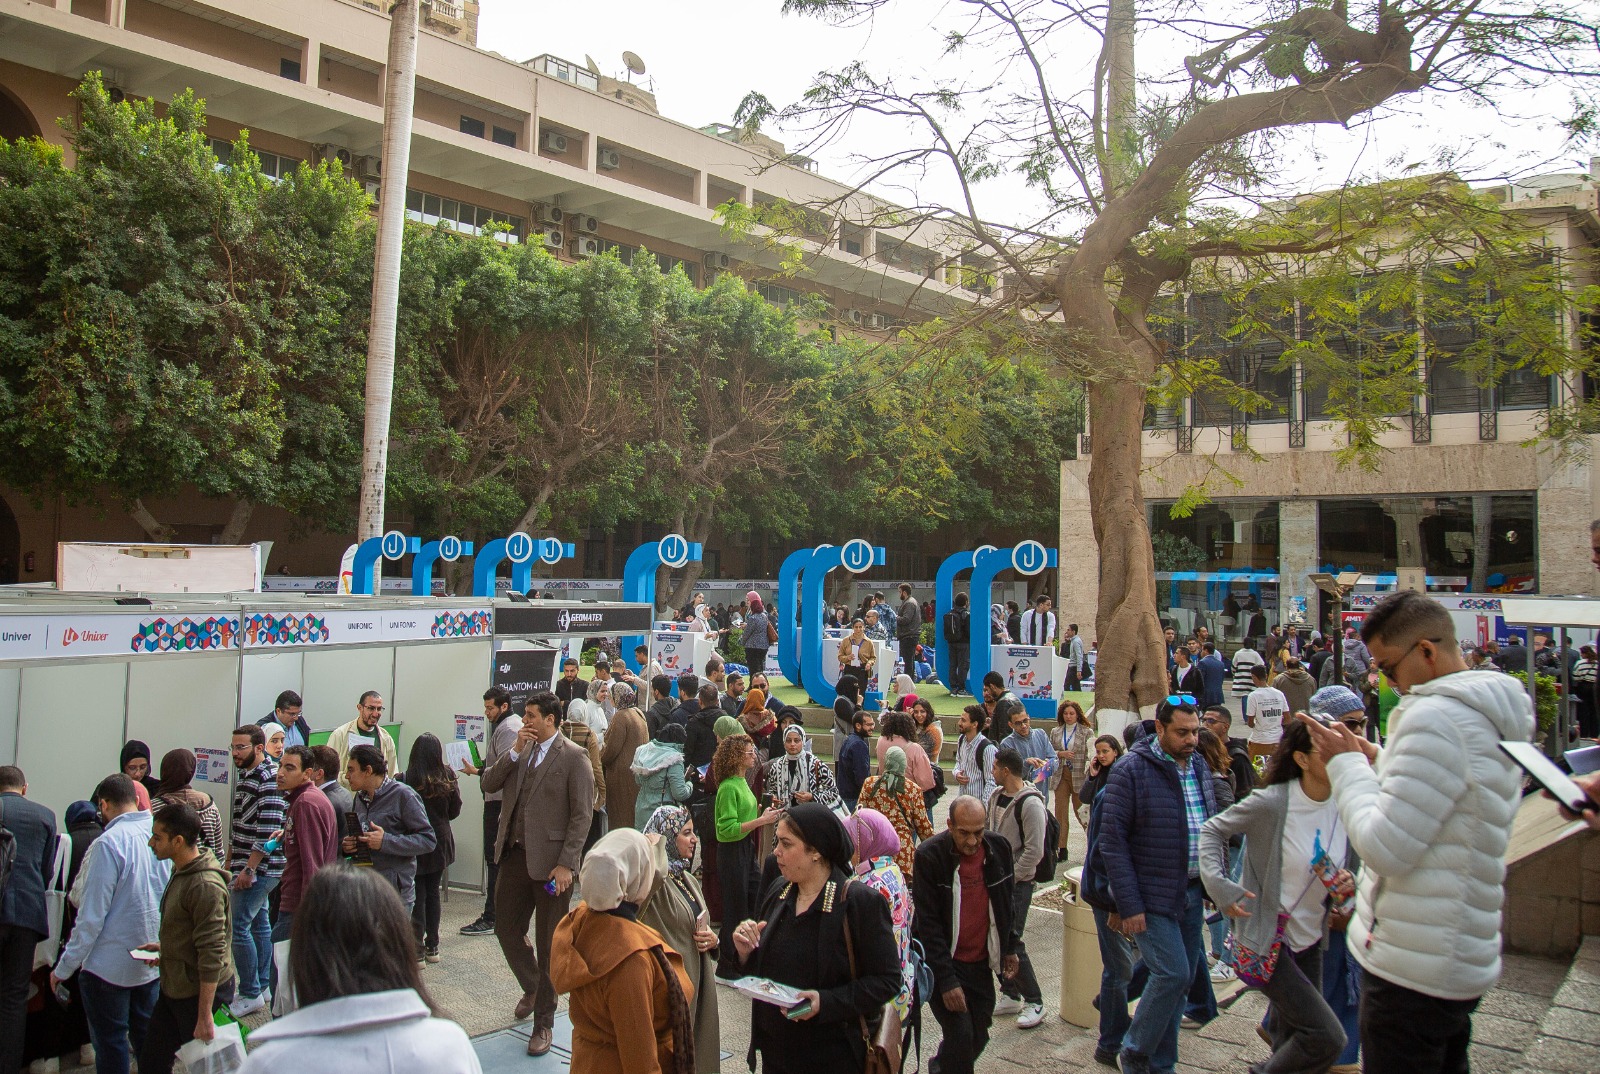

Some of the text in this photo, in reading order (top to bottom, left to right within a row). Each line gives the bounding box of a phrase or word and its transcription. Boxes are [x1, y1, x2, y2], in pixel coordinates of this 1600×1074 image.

[571, 613, 603, 621] GEOMATEX
[2, 632, 31, 641] Univer
[81, 631, 109, 641] Univer
[1262, 707, 1282, 717] value
